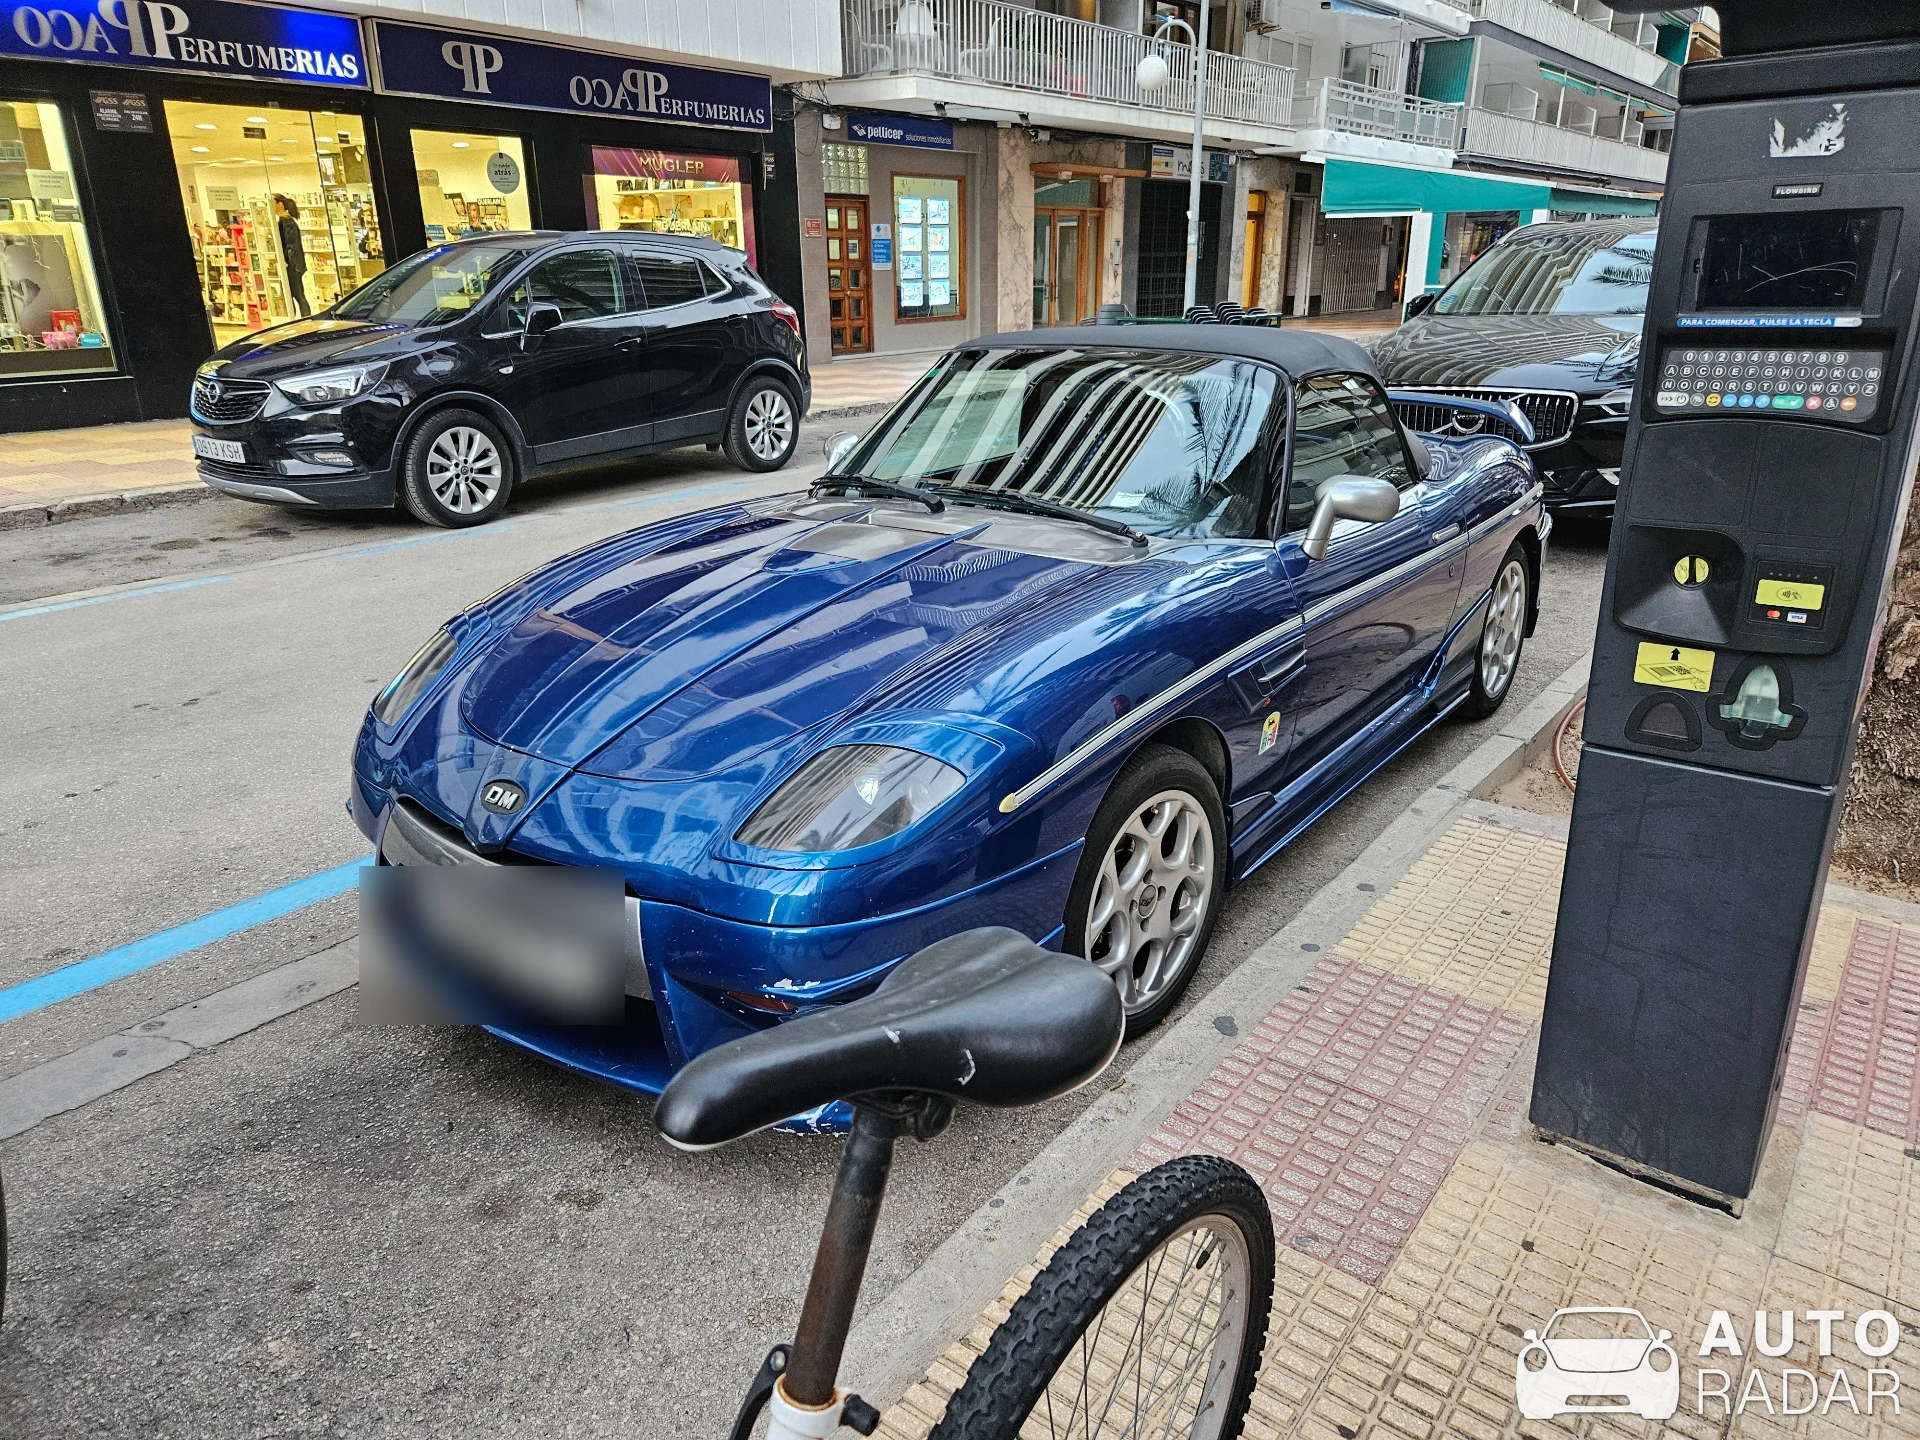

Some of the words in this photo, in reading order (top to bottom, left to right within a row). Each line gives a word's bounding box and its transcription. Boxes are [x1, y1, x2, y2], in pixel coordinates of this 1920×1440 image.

[143, 0, 359, 79] PERFUMERIAS
[647, 71, 765, 124] PERFUMERIAS
[867, 126, 904, 140] pellicer
[905, 133, 927, 142] soluciones
[927, 136, 952, 145] inmobiliarias
[639, 157, 705, 175] MUGLER
[1776, 187, 1818, 195] FLOWBIRD
[661, 220, 708, 232] GUERLAIN
[1705, 319, 1758, 327] COMENZAR,
[1803, 318, 1832, 326] TECLA
[197, 438, 219, 457] 0913
[219, 442, 242, 460] KSH
[484, 785, 519, 810] DM
